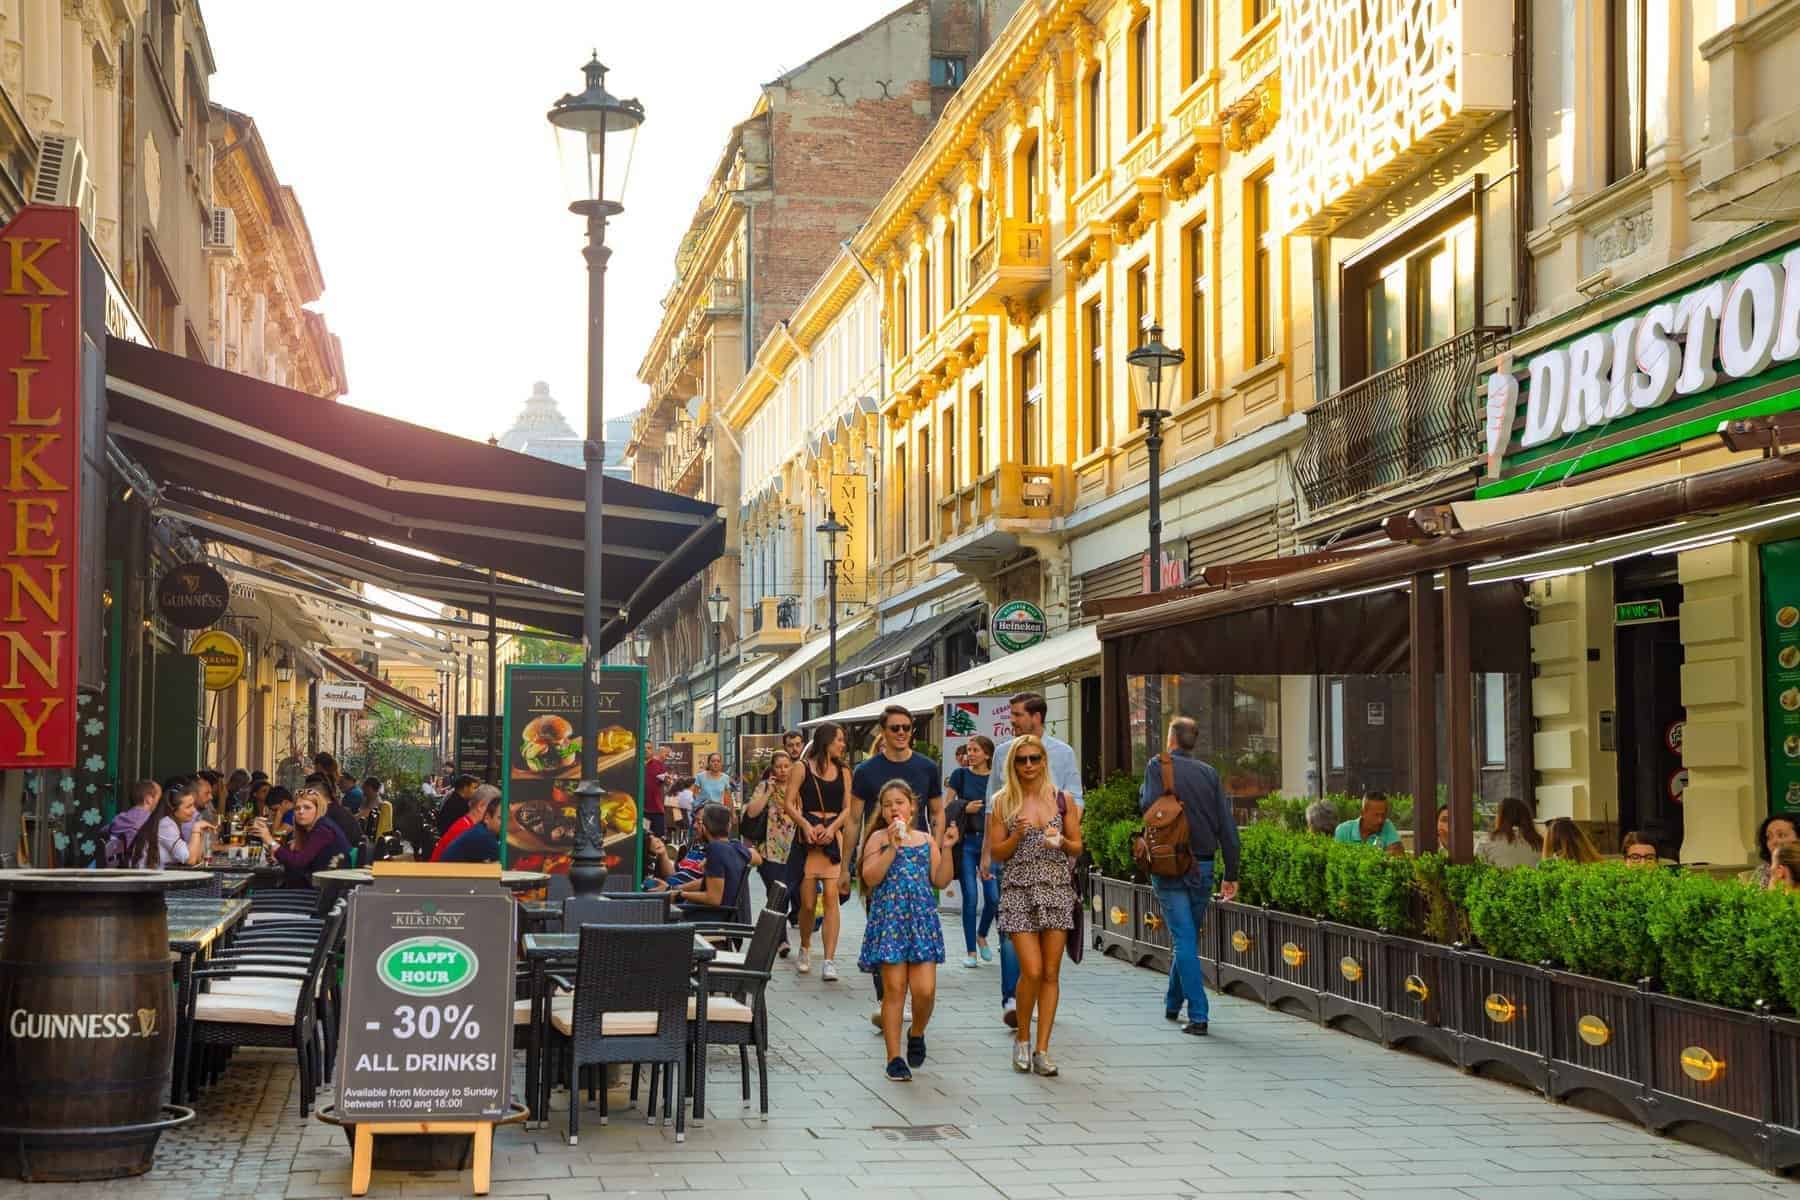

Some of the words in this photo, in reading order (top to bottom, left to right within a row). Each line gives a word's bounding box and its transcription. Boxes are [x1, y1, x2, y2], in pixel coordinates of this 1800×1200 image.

[1, 237, 68, 757] KILKENNY
[161, 591, 223, 608] GUINNESS
[1632, 605, 1648, 617] WC
[999, 621, 1041, 632] Heineken
[535, 695, 615, 708] KILKEY
[395, 915, 462, 926] KILKENNY
[401, 951, 457, 964] HAPPY
[401, 970, 449, 983] HOUR
[10, 1008, 131, 1038] GUINNESS
[392, 1004, 480, 1040] 30%
[355, 1054, 399, 1072] ALL
[405, 1053, 496, 1072] DRINKS!
[344, 1087, 387, 1097] Available
[390, 1087, 411, 1097] from
[413, 1087, 450, 1099] Monday
[452, 1088, 461, 1097] to
[463, 1087, 498, 1098] Sunday
[344, 1098, 384, 1109] between
[387, 1098, 411, 1109] 11:00
[413, 1098, 432, 1108] and
